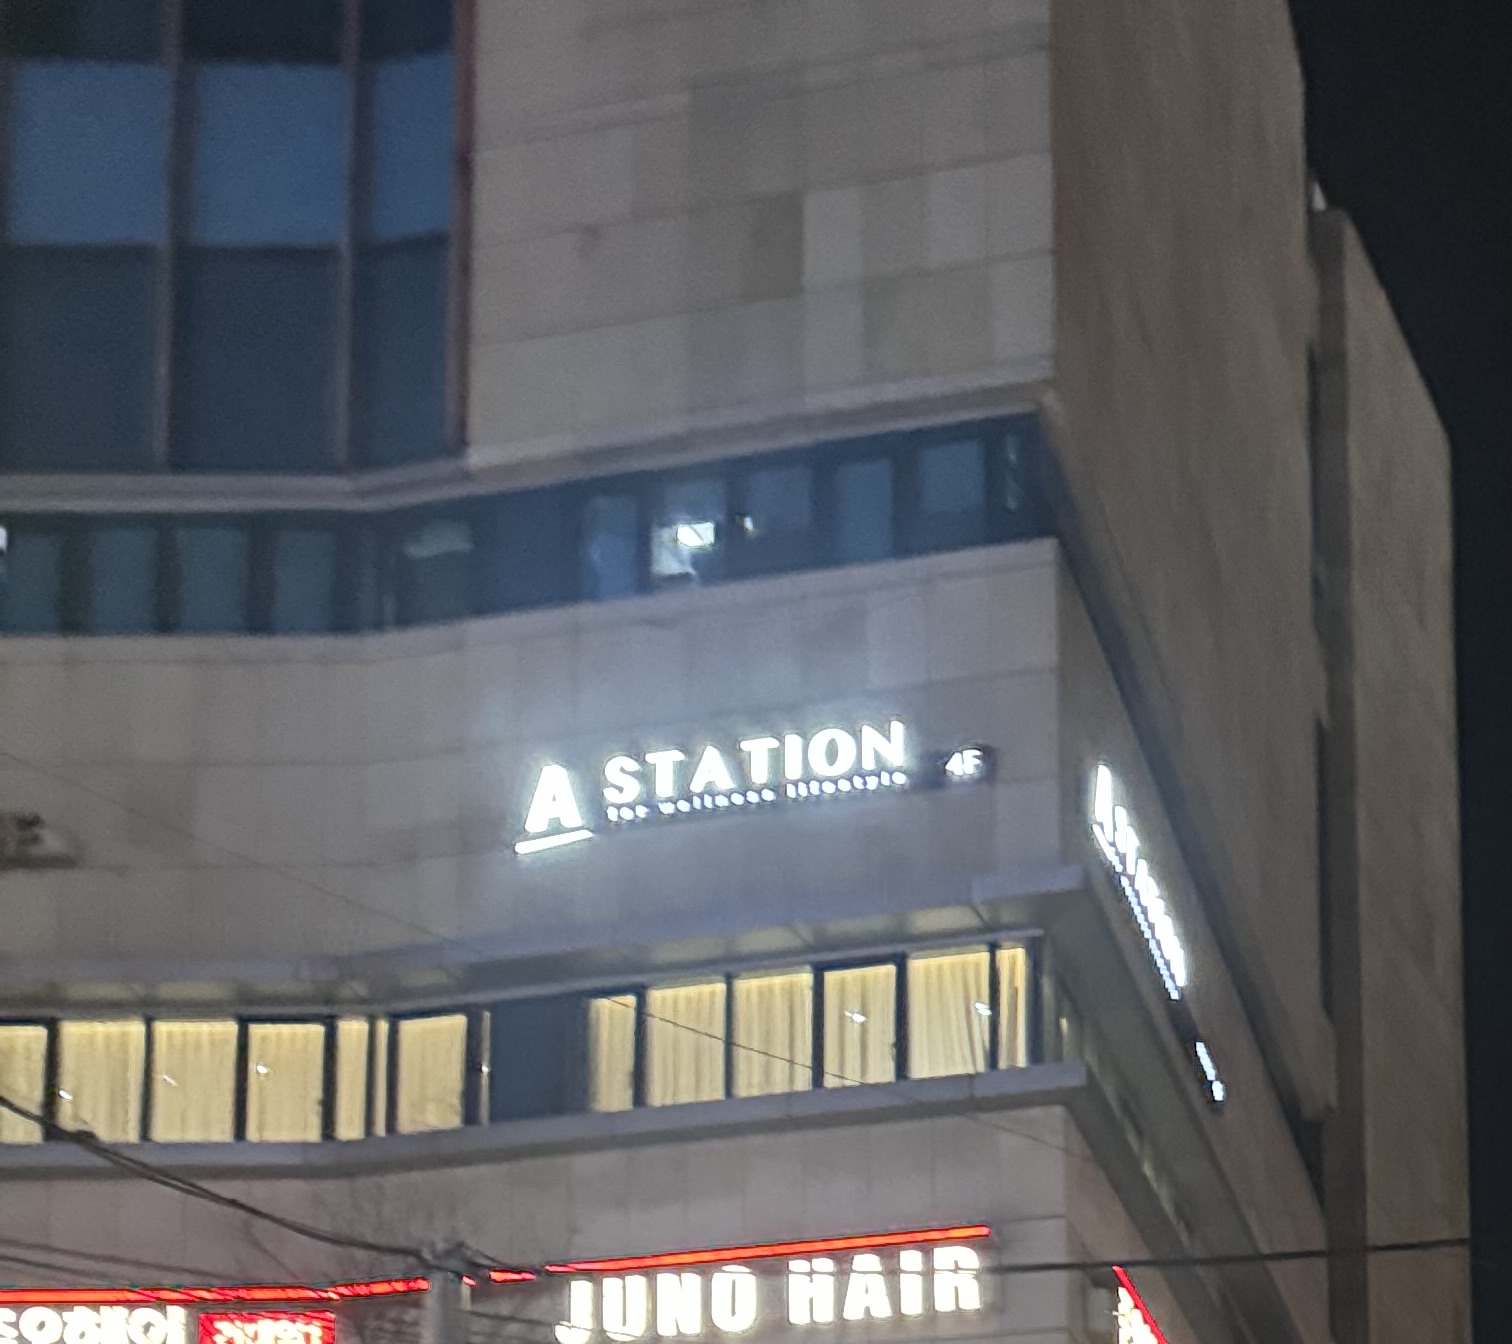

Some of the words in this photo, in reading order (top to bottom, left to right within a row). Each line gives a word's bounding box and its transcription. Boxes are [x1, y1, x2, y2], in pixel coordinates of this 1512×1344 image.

[523, 763, 586, 834] A
[602, 719, 906, 803] STATION
[944, 748, 983, 776] 4F
[788, 1245, 981, 1326] HAIR
